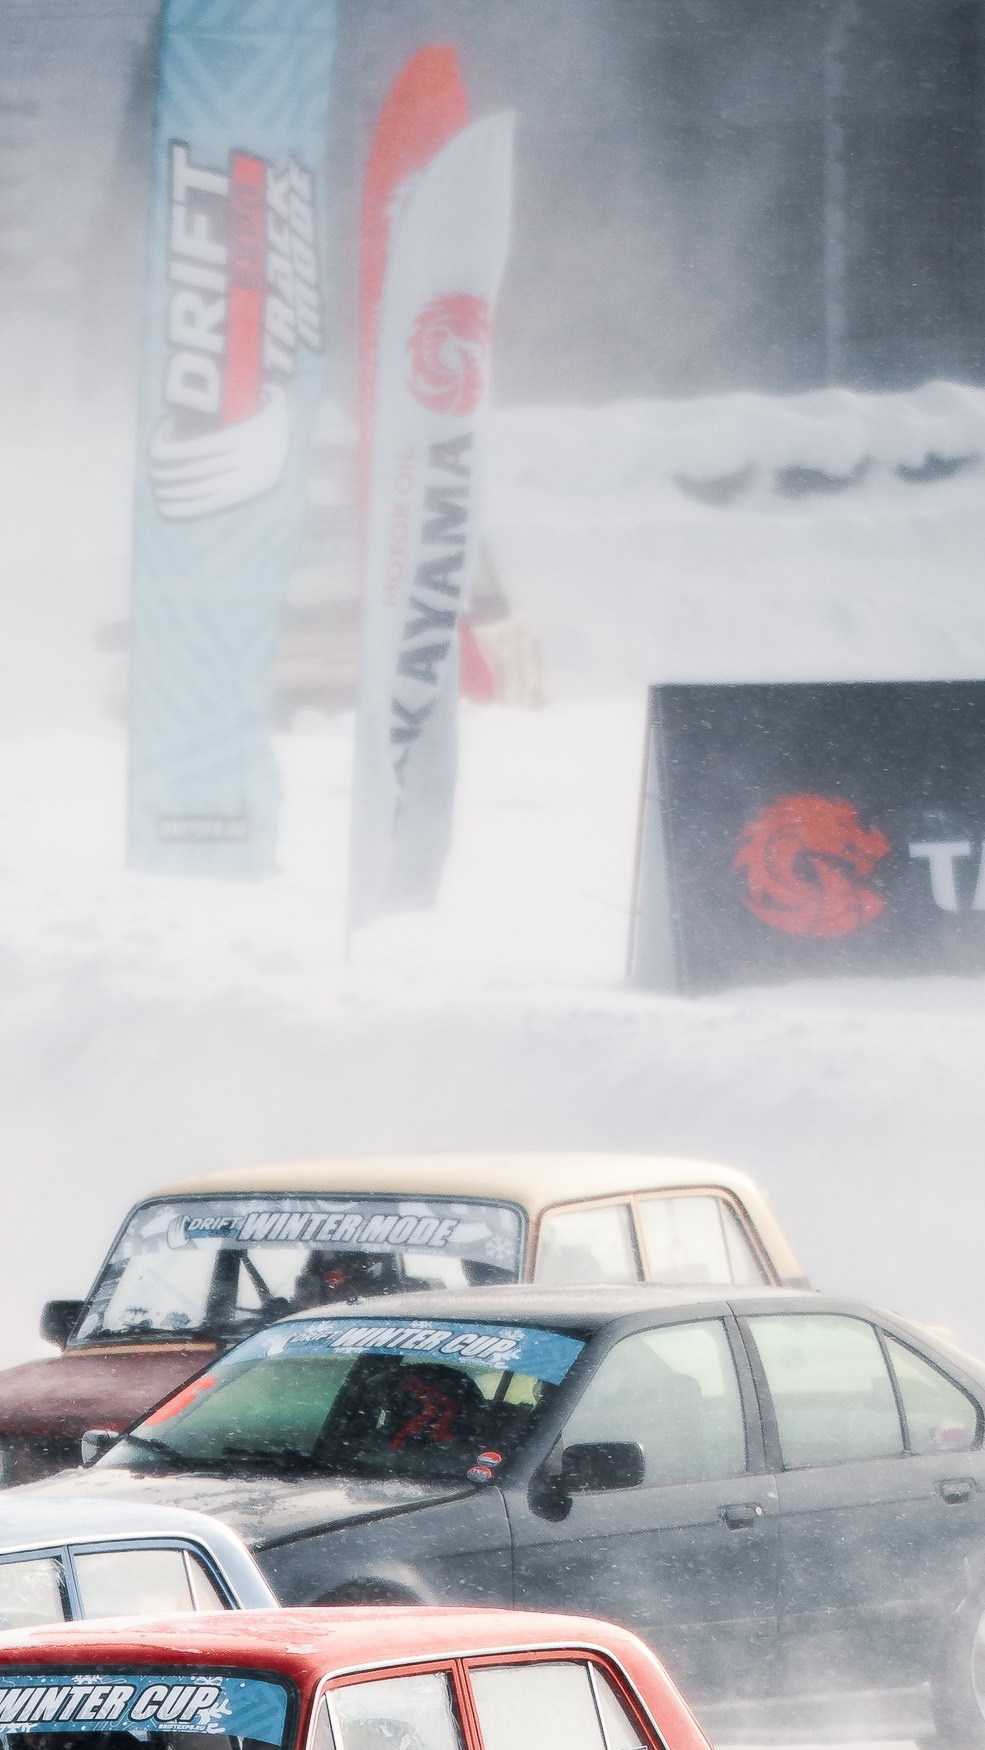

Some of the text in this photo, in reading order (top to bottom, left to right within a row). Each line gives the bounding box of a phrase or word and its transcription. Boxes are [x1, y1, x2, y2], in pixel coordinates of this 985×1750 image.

[166, 144, 230, 415] DRIFT
[382, 446, 416, 608] MOTOR OIL
[188, 1211, 460, 1247] DRIFT WINTER MODE
[329, 1327, 453, 1351] WINTER
[439, 1332, 519, 1358] CUP
[128, 1684, 220, 1723] CUP
